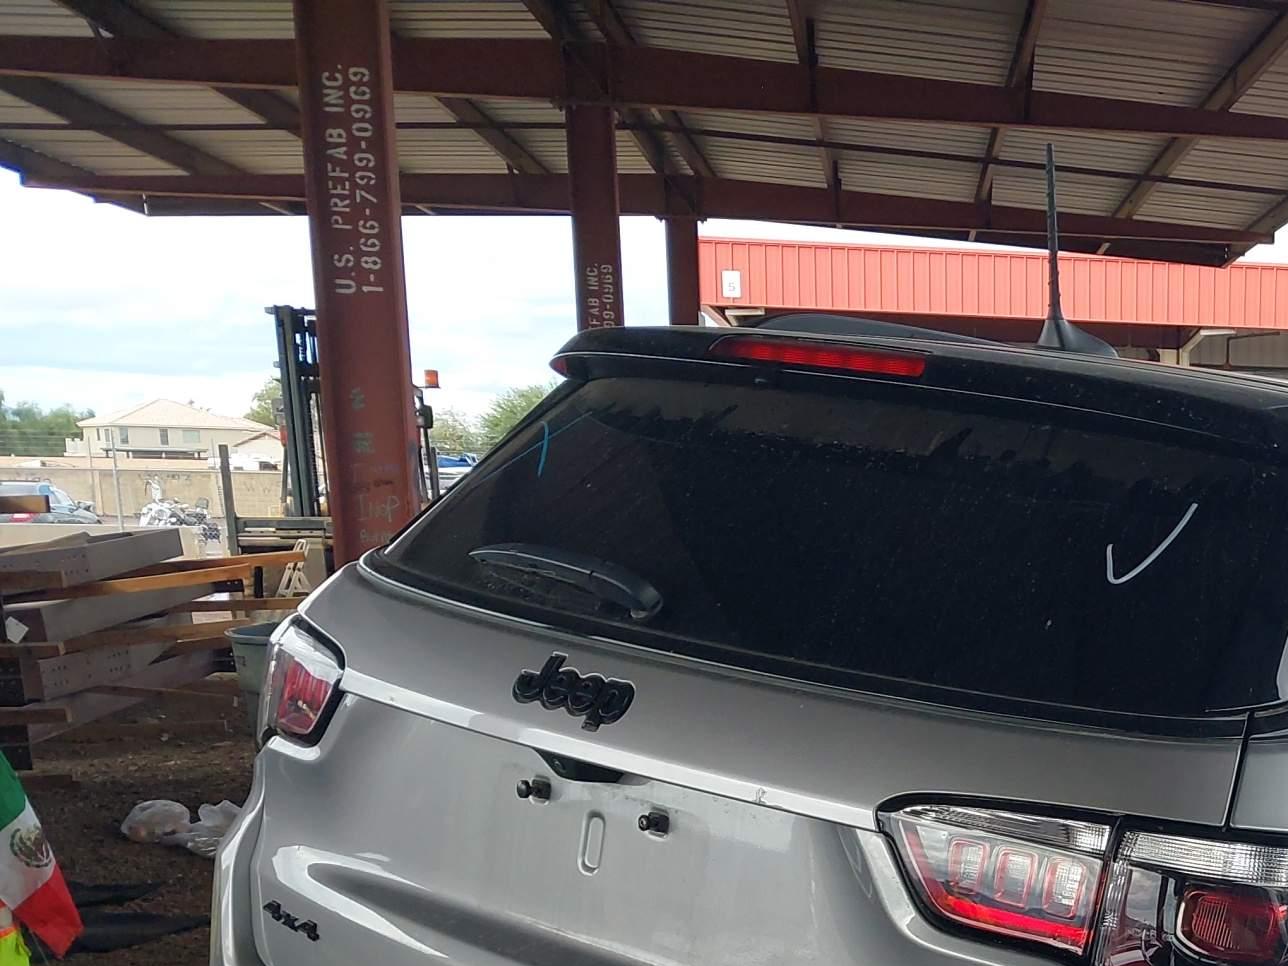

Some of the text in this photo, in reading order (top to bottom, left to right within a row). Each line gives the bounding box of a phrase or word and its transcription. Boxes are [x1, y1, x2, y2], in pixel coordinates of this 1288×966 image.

[321, 64, 357, 294] U.S. PREFAB INC.
[348, 67, 384, 293] 1-866-799-0969
[586, 263, 601, 329] FAB INC.
[512, 651, 636, 732] Jeep
